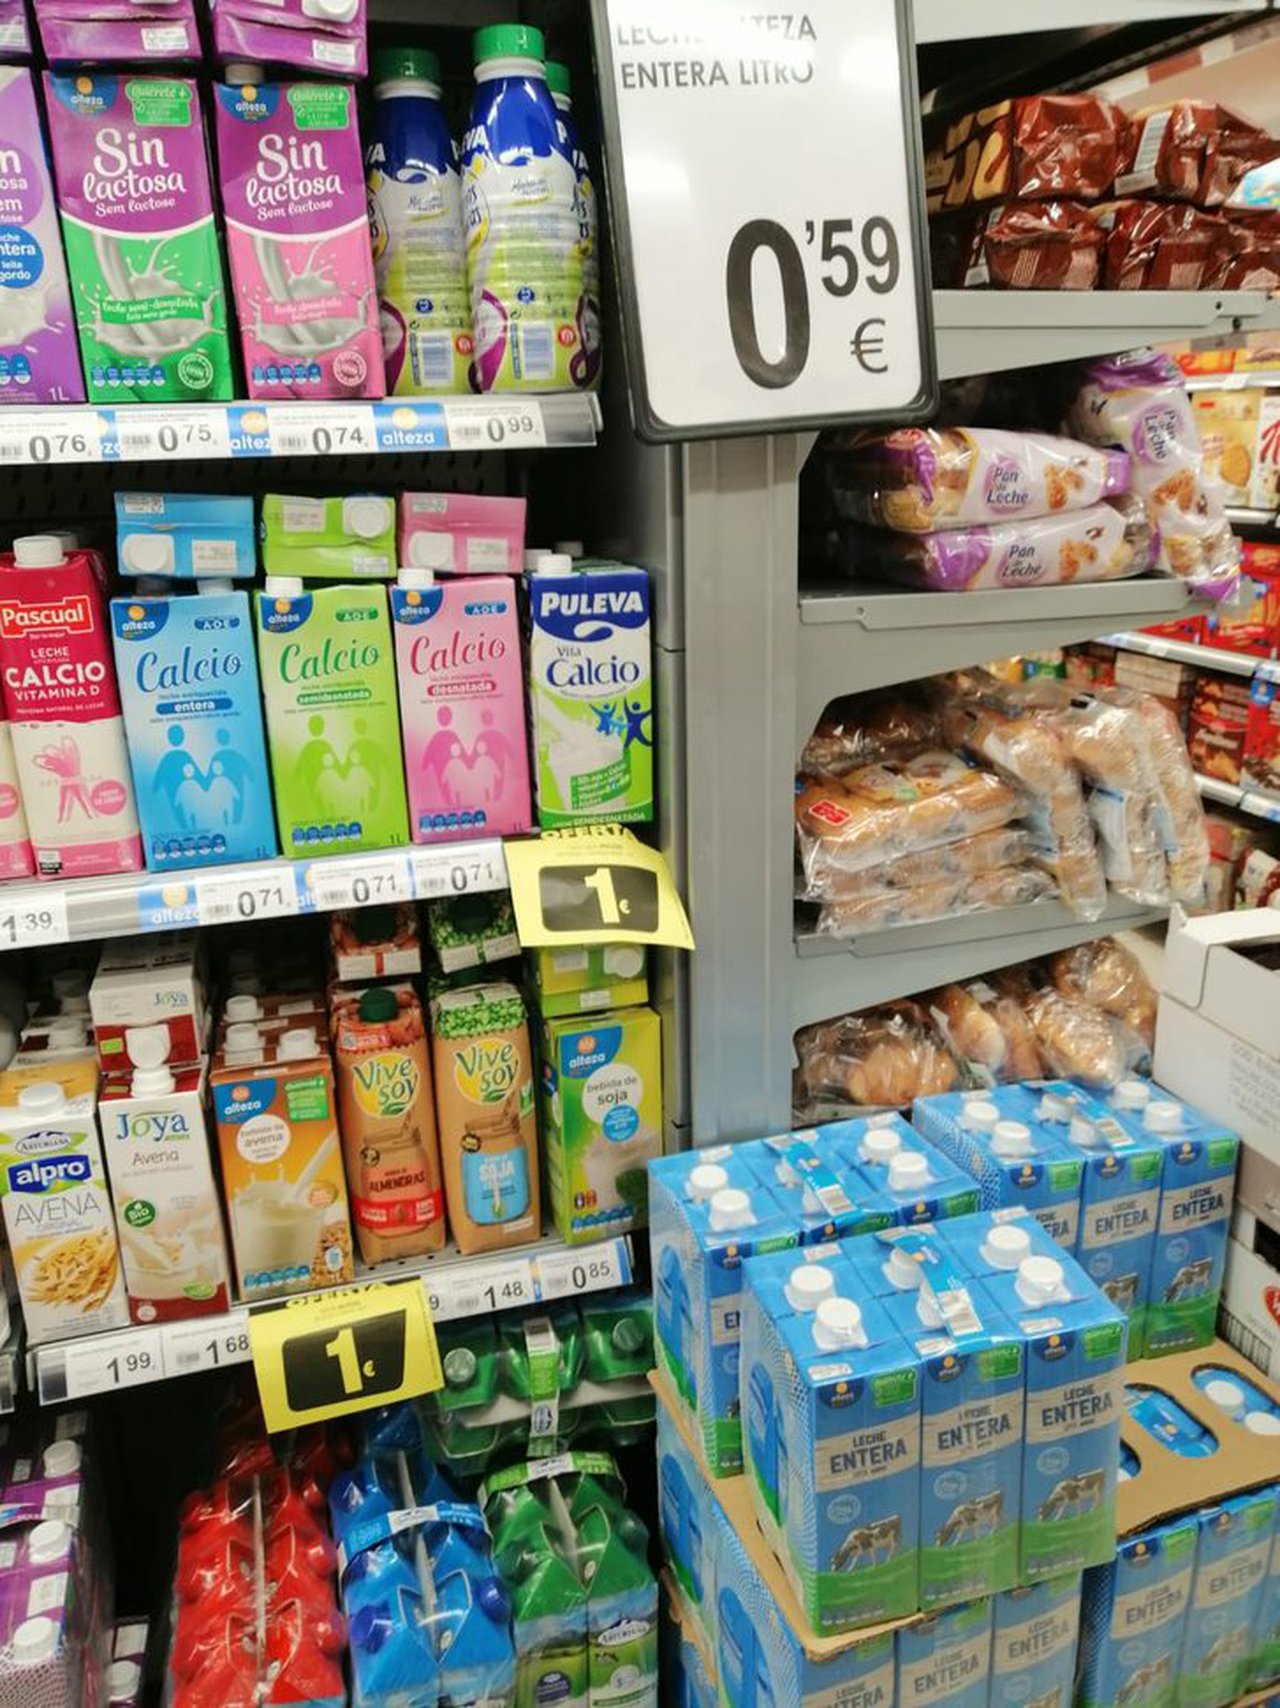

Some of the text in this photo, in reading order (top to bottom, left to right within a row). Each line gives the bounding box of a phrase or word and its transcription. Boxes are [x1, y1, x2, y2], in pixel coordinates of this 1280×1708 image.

[620, 60, 729, 89] ENTERA
[92, 127, 169, 177] Sin
[256, 132, 328, 182] Sin
[82, 172, 187, 203] lactosa
[245, 174, 345, 208] lactosa
[95, 202, 127, 217] Sem
[256, 206, 287, 222] Sem
[0, 243, 36, 256] ntera
[849, 318, 889, 374] €
[381, 429, 436, 447] alteza
[993, 465, 1020, 484] Pan
[986, 488, 1030, 506] Leche
[1008, 545, 1036, 561] Pan
[1001, 562, 1041, 579] Leche
[2, 602, 86, 627] Pascual
[540, 591, 645, 617] PULEVA
[30, 646, 71, 659] LECHE
[280, 638, 380, 684] Calcio
[410, 630, 507, 676] Calcio
[5, 661, 107, 688] CALCIO
[137, 646, 242, 693] Calcio
[546, 655, 641, 689] Calcio
[15, 686, 101, 702] VITAMINA D
[174, 700, 216, 714] entera
[352, 1058, 414, 1092] Vive
[456, 1044, 513, 1077] Vive
[378, 1074, 418, 1106] soy
[480, 1060, 519, 1092] soy
[597, 1090, 629, 1106] soja
[117, 1111, 189, 1141] Joya
[16, 1161, 88, 1190] alpro
[15, 1192, 101, 1226] AVENA
[1171, 1192, 1226, 1221] ENTERA
[1094, 1208, 1149, 1236] ENTERA
[1041, 1390, 1114, 1428] ENTERA
[938, 1413, 1013, 1451] ENTERA
[830, 1438, 908, 1475] ENTERA
[1007, 1620, 1071, 1660] ENTERA
[913, 1653, 980, 1694] ENTERA
